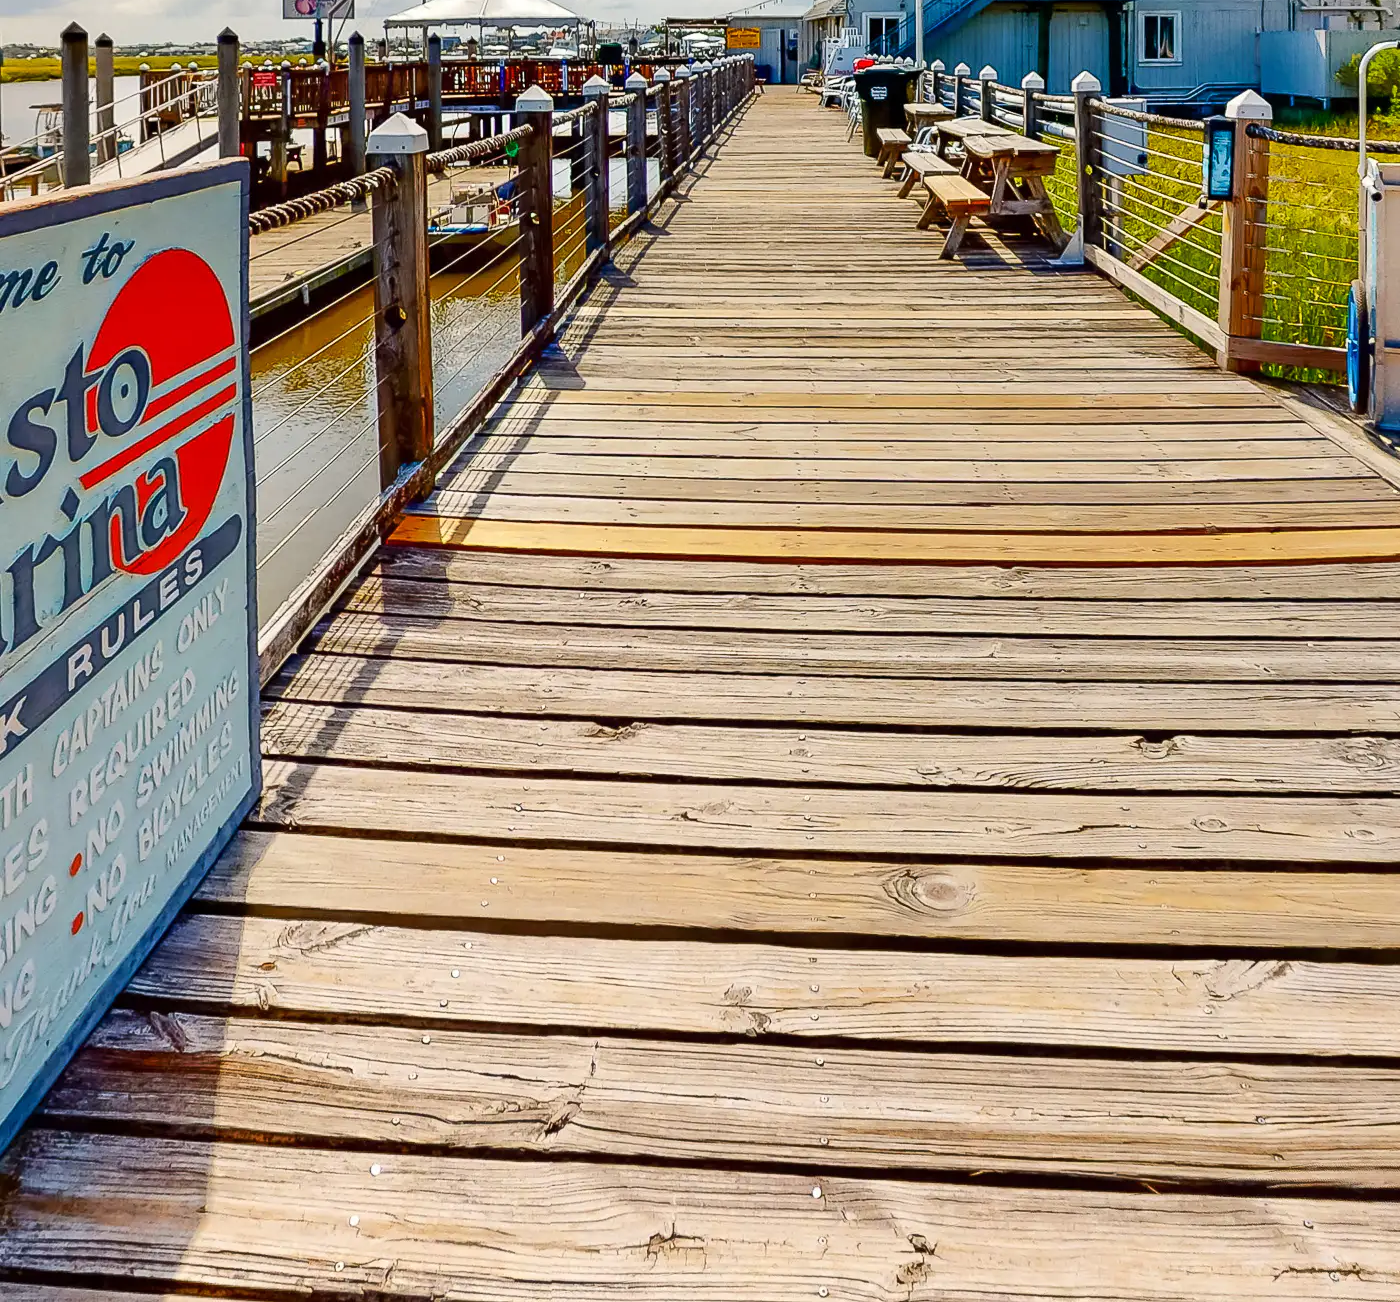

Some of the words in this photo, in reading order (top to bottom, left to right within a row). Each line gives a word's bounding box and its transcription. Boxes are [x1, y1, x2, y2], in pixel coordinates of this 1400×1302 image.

[81, 232, 136, 285] to
[0, 457, 188, 655] rina
[67, 550, 204, 691] RULES
[0, 763, 33, 831] TH
[52, 639, 164, 779] CAPTAINS
[177, 577, 229, 654] ONLY
[0, 818, 49, 901] ES
[69, 666, 197, 828] REQUIRED
[86, 799, 126, 871] NO
[136, 668, 240, 808] SWIMMING
[86, 853, 127, 928] NO
[138, 719, 233, 862] BICYCLES
[165, 753, 244, 874] MANAGEMENT
